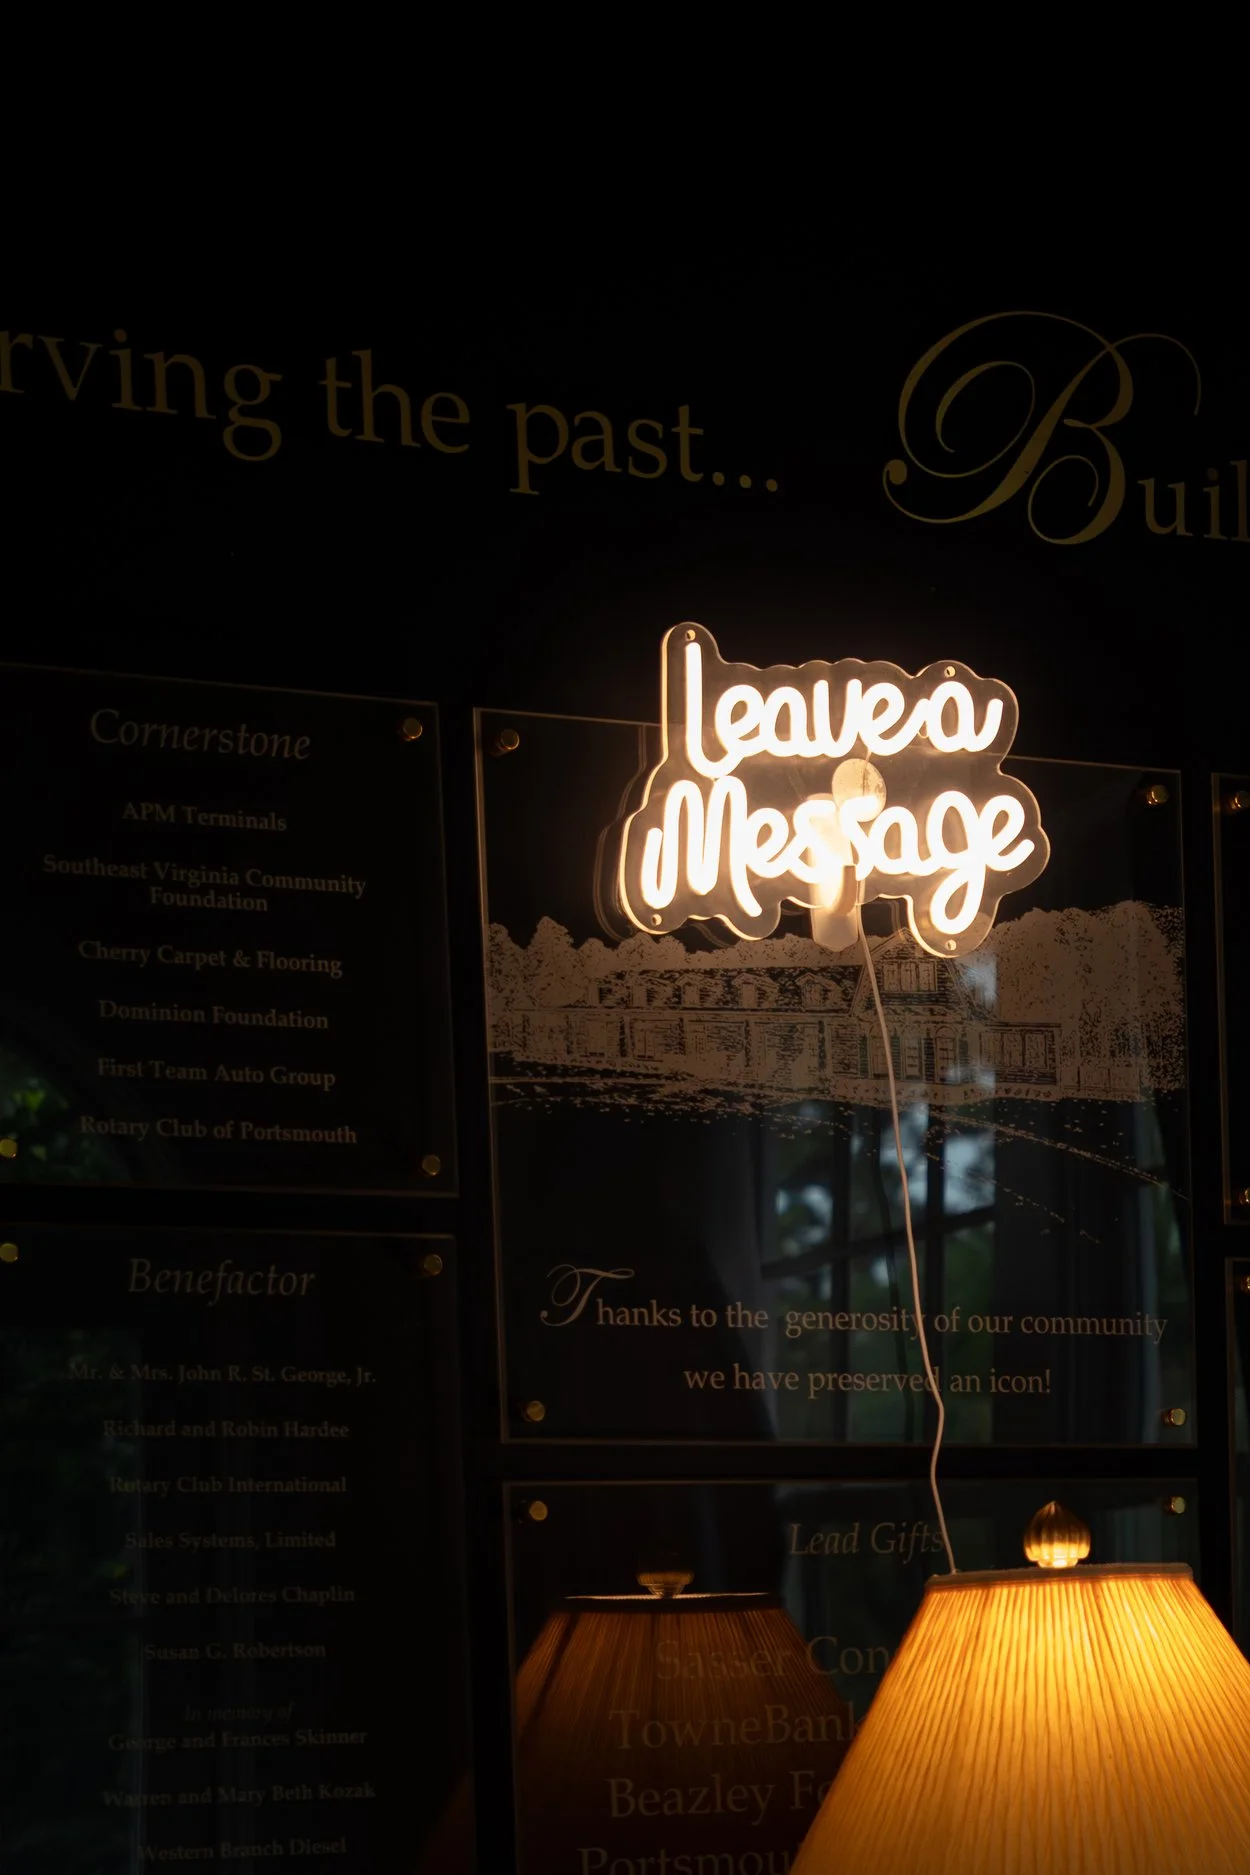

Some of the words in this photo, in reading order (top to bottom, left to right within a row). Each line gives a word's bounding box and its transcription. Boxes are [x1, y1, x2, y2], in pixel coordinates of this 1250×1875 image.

[320, 349, 470, 453] the
[506, 403, 778, 495] past...
[684, 642, 931, 778] Leave
[926, 680, 1004, 754] a
[90, 709, 310, 760] Cornerstone
[123, 802, 175, 822] APM
[182, 806, 286, 831] Terminals
[43, 854, 147, 879] Southeast
[153, 861, 239, 887] Virginia
[245, 869, 366, 899] Community
[640, 775, 1035, 935] Message
[150, 886, 268, 912] Foundation
[78, 941, 150, 966] Cherry
[157, 945, 225, 970] Carpet
[233, 950, 250, 967] &
[257, 951, 343, 979] Flooring
[98, 1000, 205, 1022] Dominion
[213, 1006, 328, 1028] Foundation
[98, 1058, 145, 1077] First
[149, 1060, 207, 1080] Team
[215, 1065, 264, 1083] Auto
[270, 1066, 336, 1091] Group
[80, 1116, 149, 1141] Rotary
[156, 1118, 207, 1137] Club
[213, 1120, 234, 1138] of
[241, 1122, 357, 1143] Portsmouth
[129, 1258, 315, 1306] Benefactor
[540, 1263, 682, 1328] Thanks
[690, 1301, 717, 1330] to
[725, 1302, 769, 1330] the
[784, 1304, 923, 1339] generosity
[934, 1306, 960, 1334] of
[966, 1312, 1014, 1334] our
[1020, 1308, 1168, 1344] community
[683, 1368, 725, 1389] we
[731, 1362, 800, 1390] have
[807, 1364, 937, 1400] preserved
[949, 1374, 982, 1393] an
[988, 1368, 1052, 1395] icon!
[104, 1418, 176, 1439] Richard
[181, 1421, 215, 1437] and
[221, 1421, 278, 1437] Robin
[285, 1421, 349, 1437] Hardee
[789, 1521, 860, 1556] Lead
[869, 1520, 945, 1563] Gifts
[655, 1639, 796, 1680] Sasser
[607, 1772, 773, 1826] Beazley
